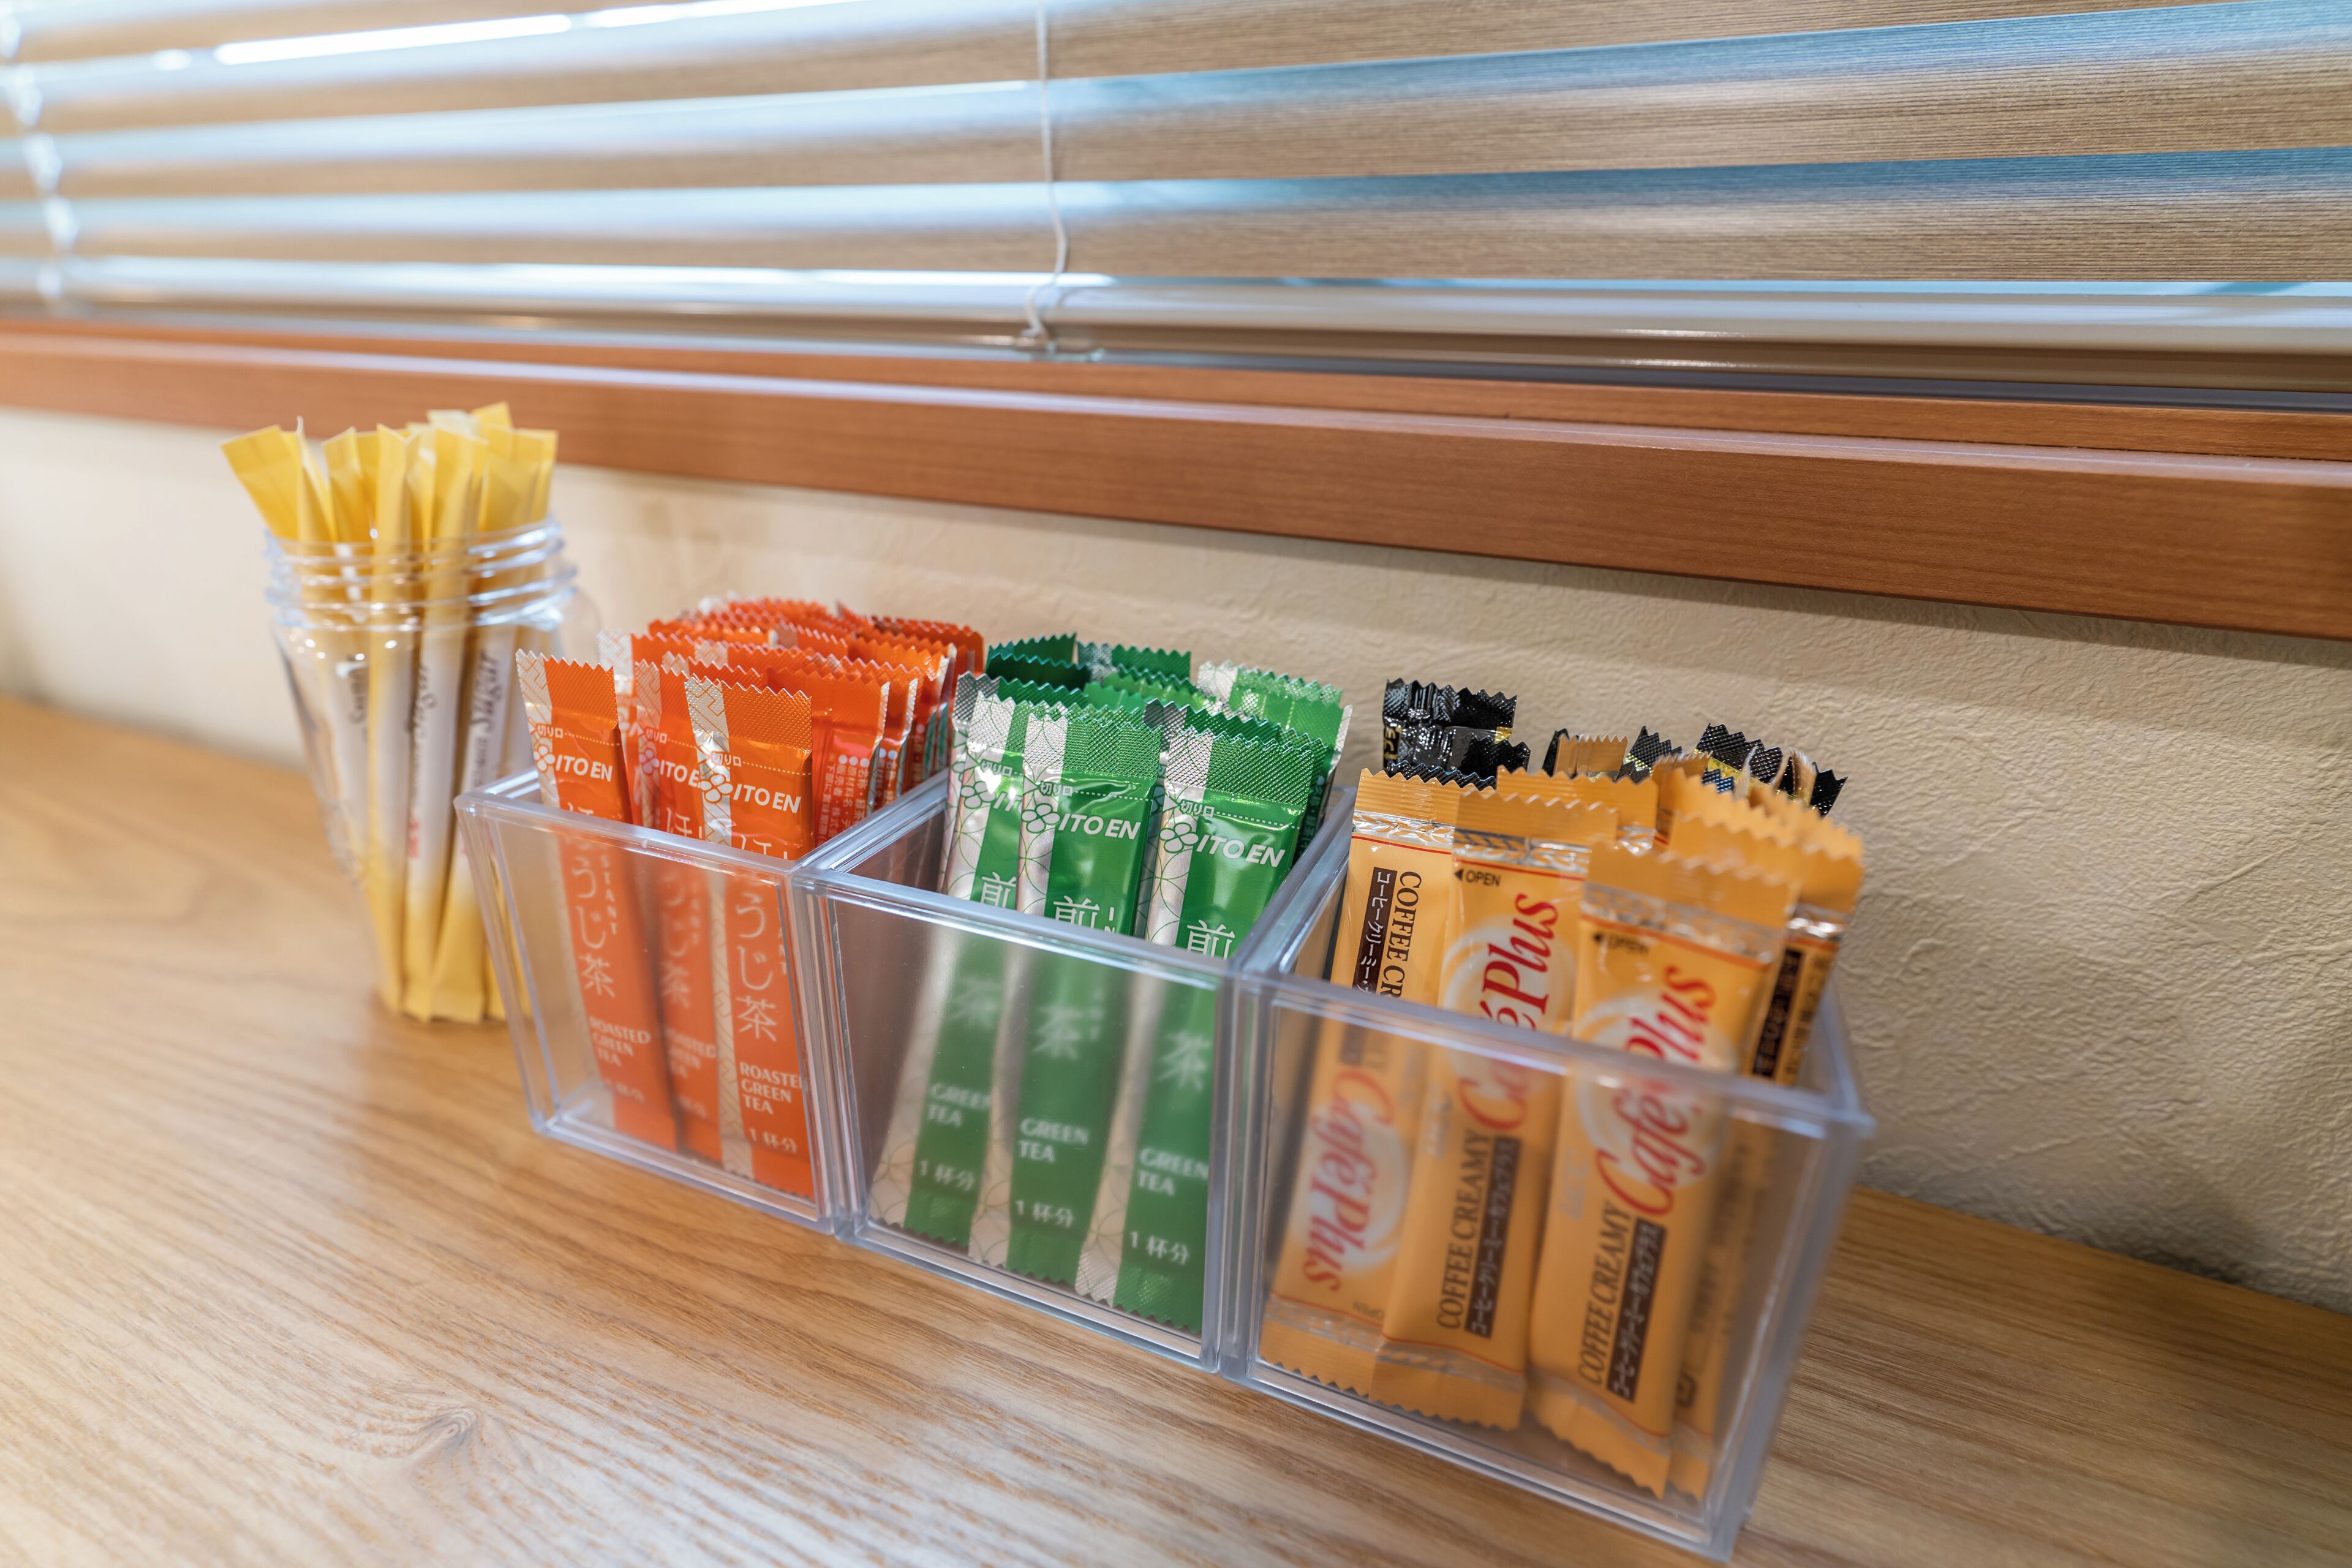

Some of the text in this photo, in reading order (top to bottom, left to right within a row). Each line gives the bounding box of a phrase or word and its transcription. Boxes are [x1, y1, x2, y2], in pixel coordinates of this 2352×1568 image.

[537, 724, 564, 739] 切り口
[646, 728, 667, 744] 切り口
[556, 755, 613, 782] ITO EN
[710, 752, 742, 767] 切り口
[981, 759, 1012, 777] 切り口
[660, 760, 701, 788] ITO E
[733, 783, 802, 813] ITO EN
[1040, 781, 1073, 797] 切り口
[993, 793, 1023, 813] IT
[1180, 800, 1215, 818] 切り口
[1058, 813, 1141, 840] ITO EN
[1196, 834, 1286, 868] ITO EN
[1466, 870, 1501, 887] OPEN
[1386, 871, 1422, 962] COFFEE
[588, 1015, 651, 1044] ROASTED
[593, 1031, 634, 1057] GREEN
[597, 1049, 622, 1068] TEA
[741, 1079, 793, 1103] GREEN
[742, 1094, 774, 1115] TEA
[928, 1104, 963, 1128] TEA
[1020, 1118, 1090, 1145] GREEN
[1019, 1140, 1056, 1163] TEA
[1139, 1148, 1210, 1180] GREEN
[1137, 1170, 1175, 1197] TEA
[1437, 1129, 1493, 1331] COFFEE CREAMY
[1577, 1200, 1632, 1385] COFFEE CREAMY
